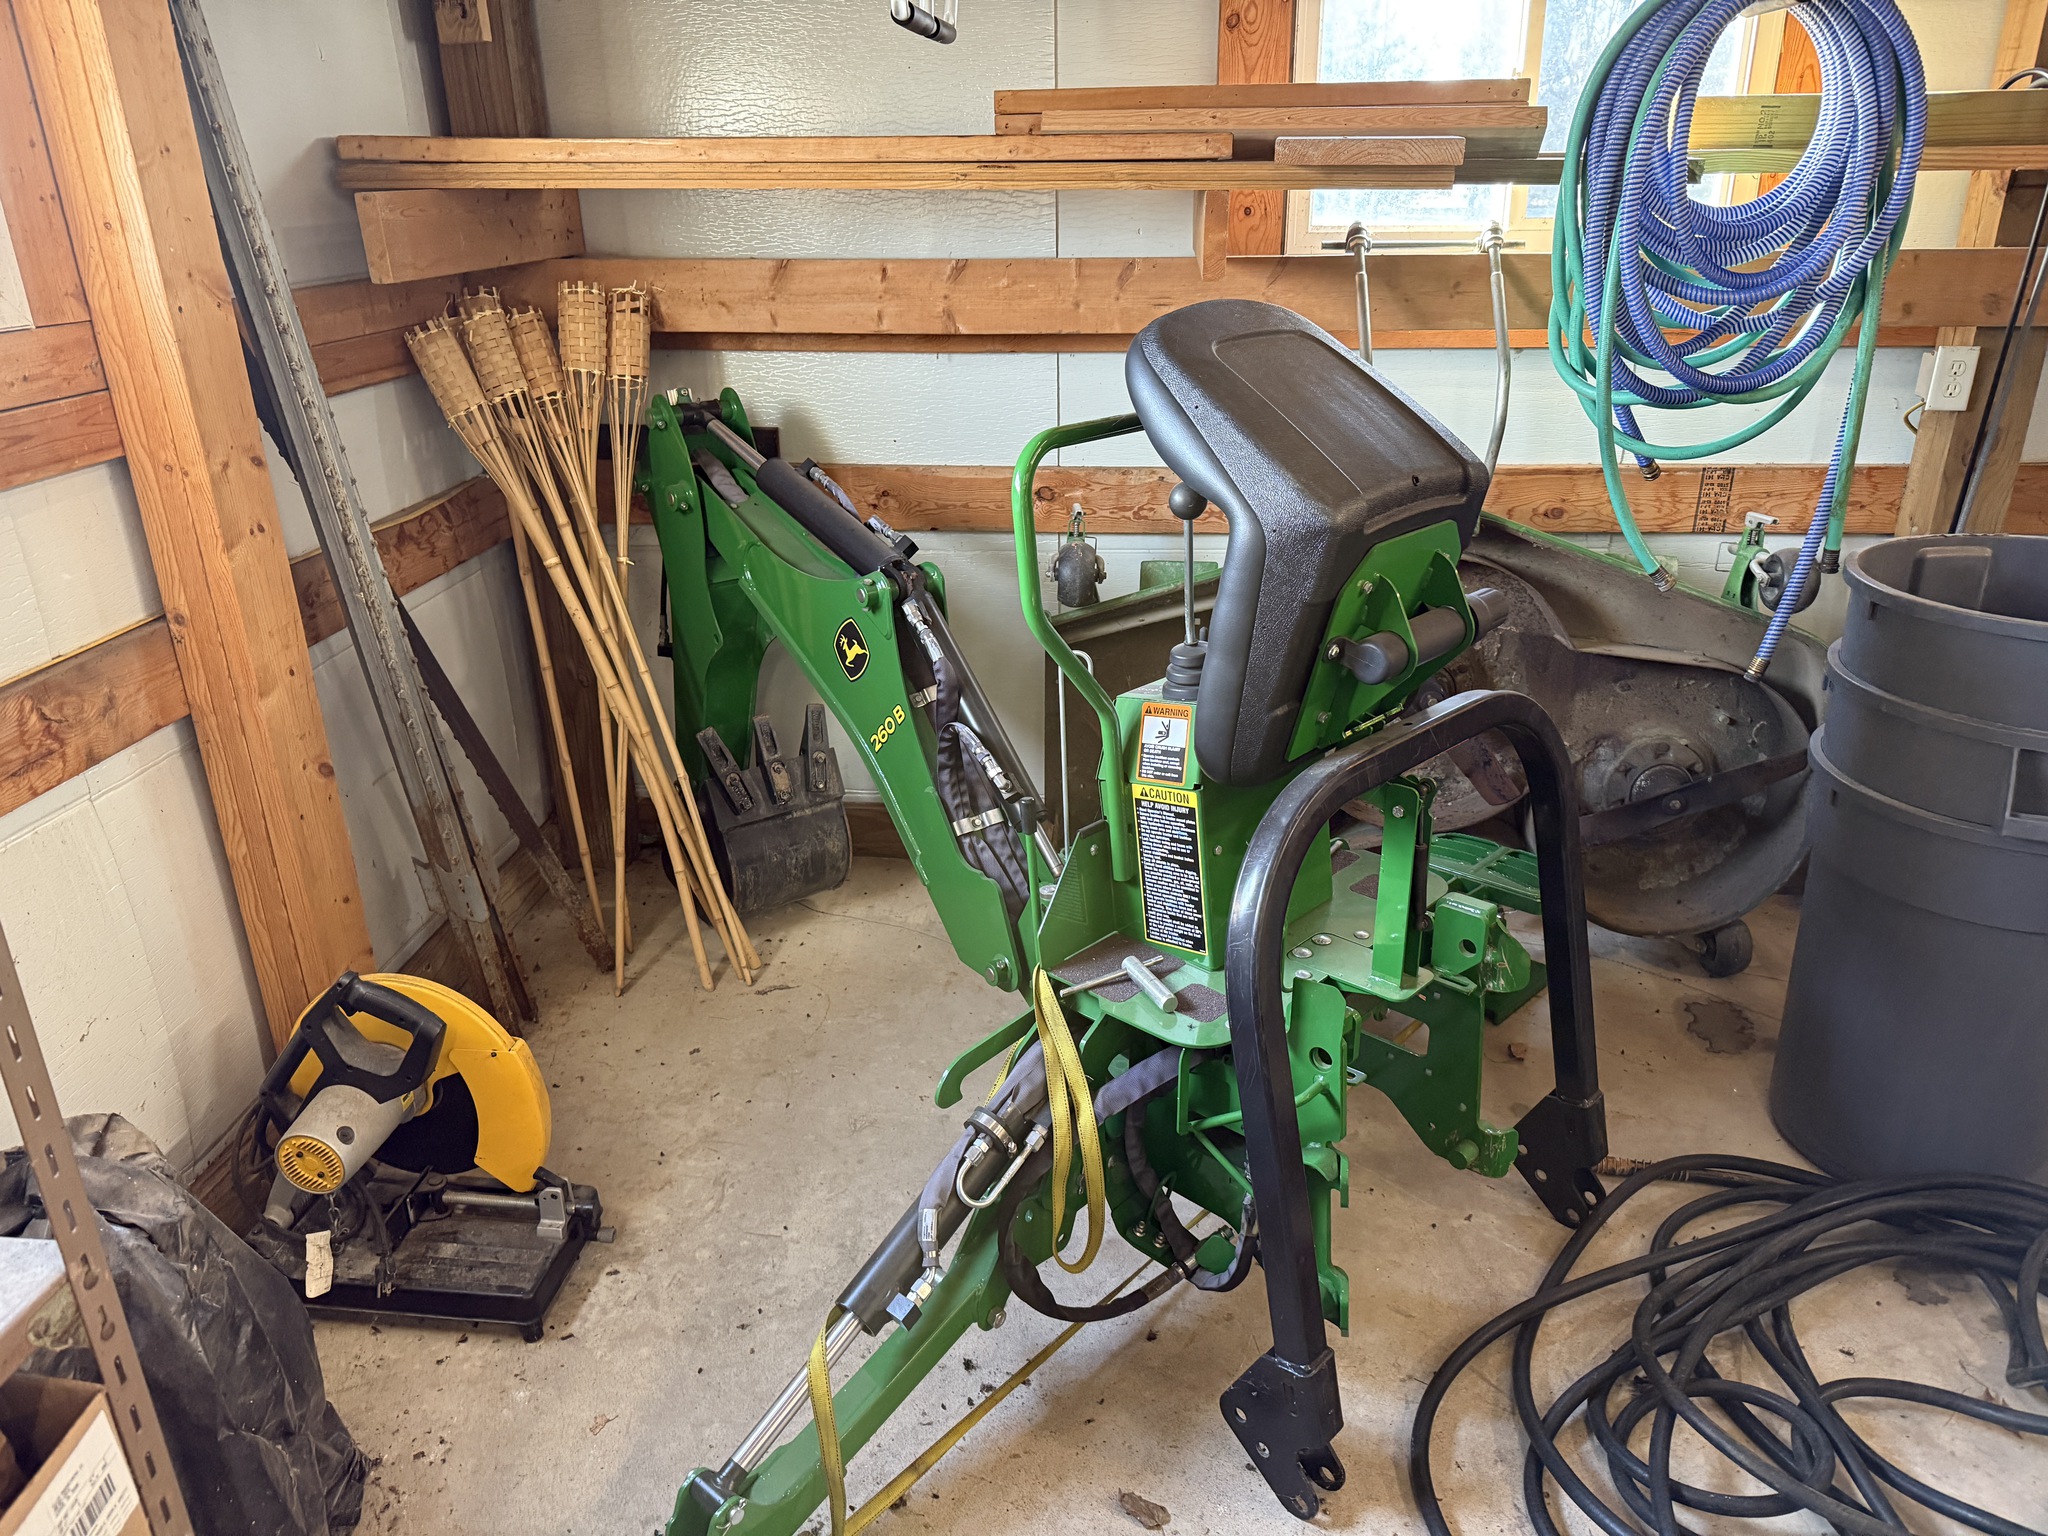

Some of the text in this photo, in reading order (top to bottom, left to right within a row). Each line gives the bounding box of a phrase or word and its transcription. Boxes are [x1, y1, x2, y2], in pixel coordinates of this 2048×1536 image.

[1153, 706, 1189, 717] WARNING
[870, 704, 906, 753] 260 B
[1149, 788, 1190, 804] CAUTION
[1141, 800, 1189, 814] HELP AVOID INJURY
